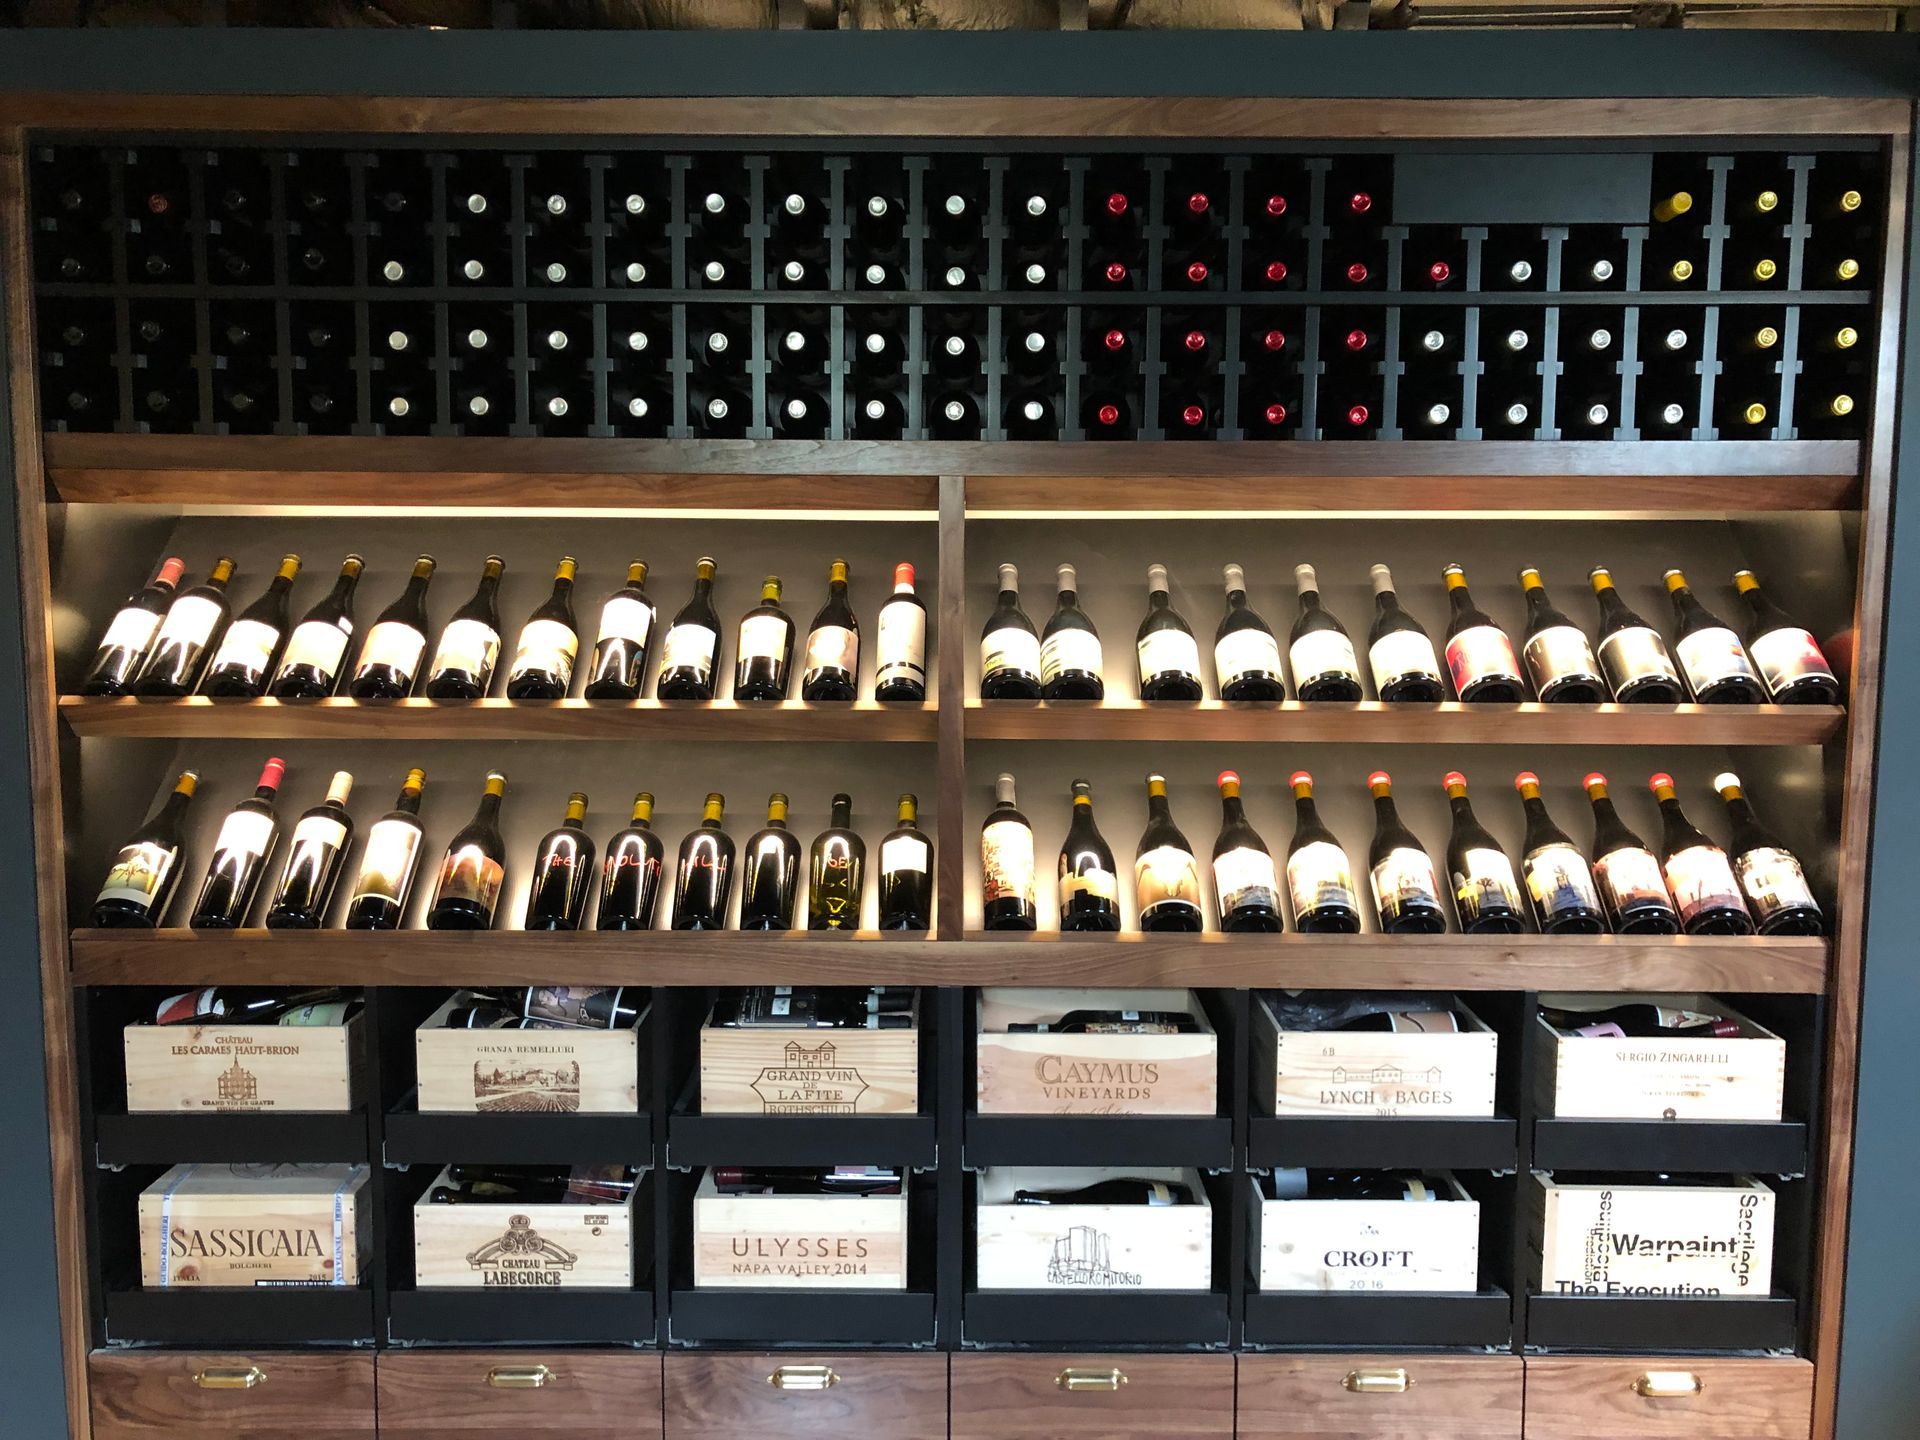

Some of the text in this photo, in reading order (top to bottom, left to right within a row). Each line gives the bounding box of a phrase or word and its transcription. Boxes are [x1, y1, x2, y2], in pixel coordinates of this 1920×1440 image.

[215, 1035, 253, 1044] CHÂTEAU
[172, 1046, 300, 1055] LES CARMES HAUT-BRION
[477, 1046, 575, 1054] GRANJA REMELLURI
[766, 1071, 853, 1081] GRAND VIN
[778, 1090, 843, 1100] LAFITE
[1042, 1087, 1151, 1100] VINEYARDS
[1320, 1091, 1453, 1104] LYNCH BAGES
[769, 1105, 851, 1114] ROTHSCHILD
[1375, 1108, 1398, 1117] 2015
[170, 1229, 324, 1258] SASSICAIA
[732, 1238, 868, 1258] ULYSSES
[1612, 1234, 1738, 1262] Warpaint
[1324, 1250, 1413, 1267] CROFT
[229, 1262, 272, 1270] BOLGHERI
[502, 1259, 540, 1269] CHATEAU
[732, 1263, 867, 1275] NAPA VALLEY 2014
[172, 1274, 200, 1282] ITALIA
[308, 1273, 327, 1281] 2015
[483, 1271, 562, 1285] LABEGORCE
[1555, 1280, 1720, 1297] The Execution
